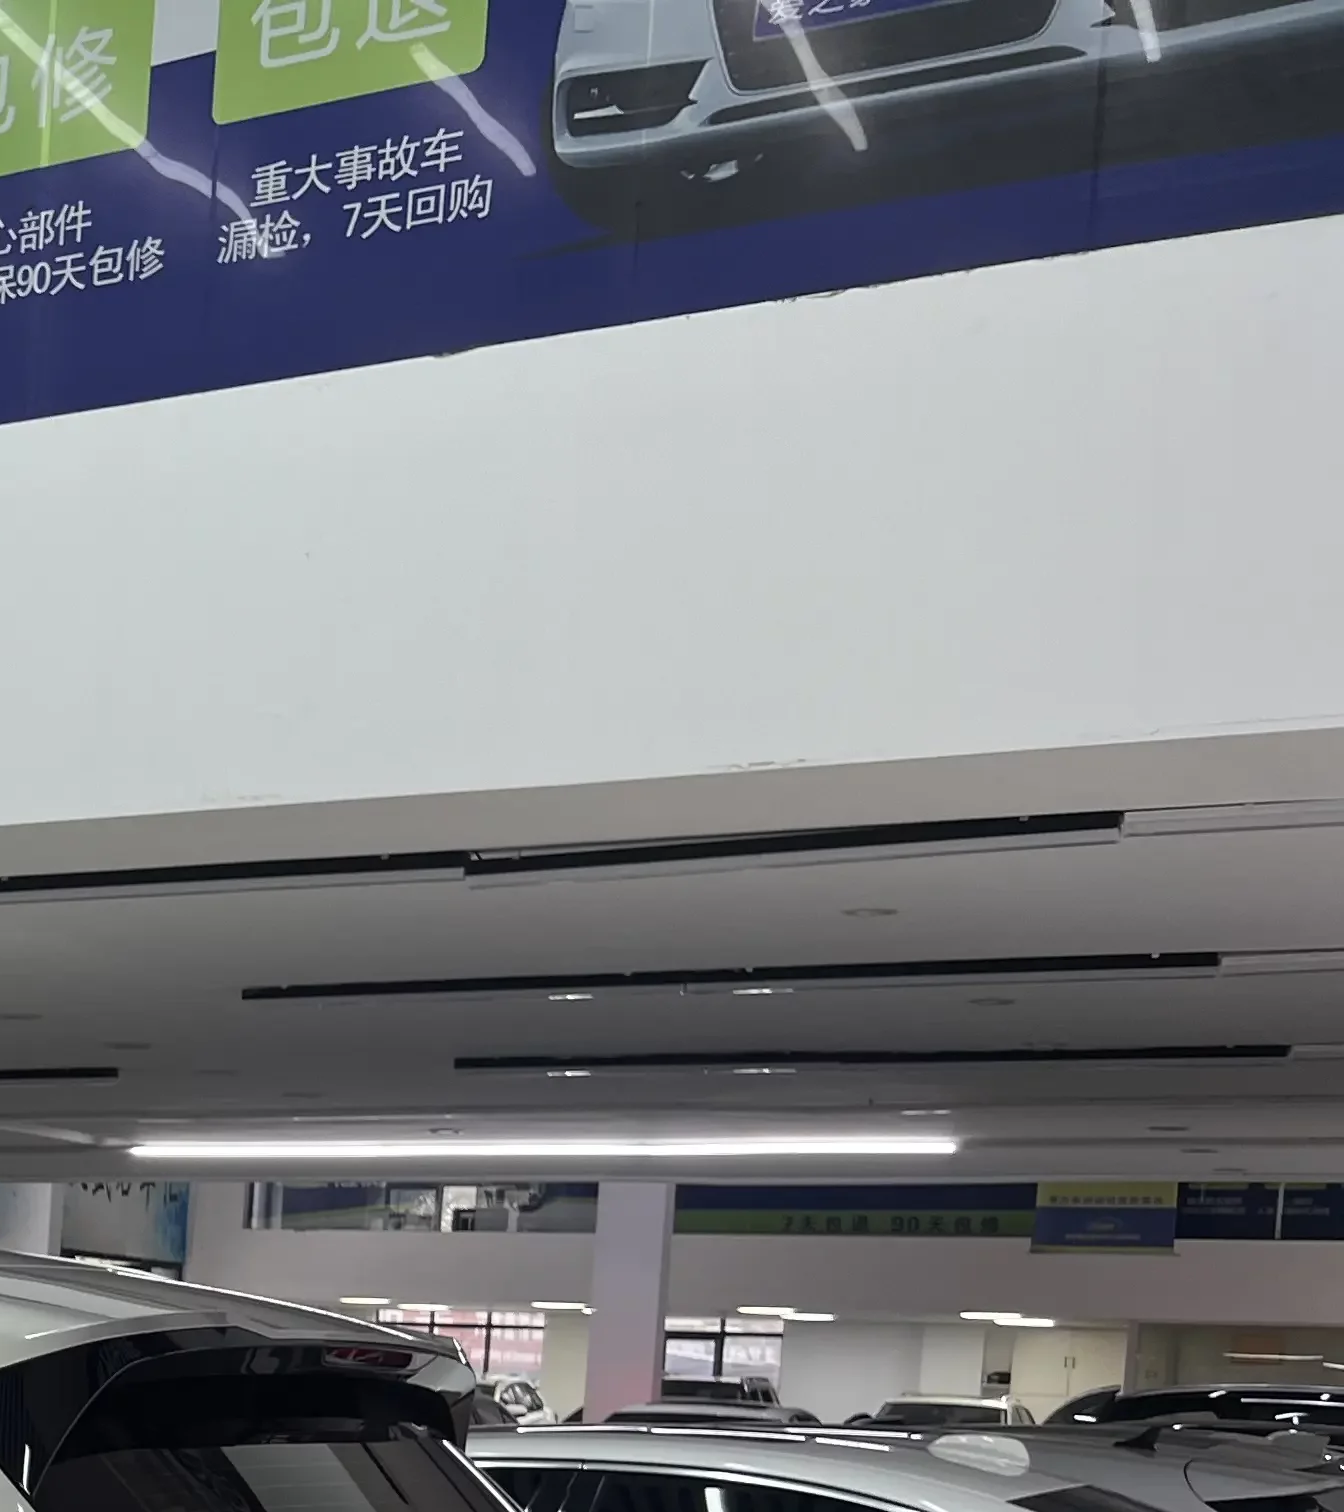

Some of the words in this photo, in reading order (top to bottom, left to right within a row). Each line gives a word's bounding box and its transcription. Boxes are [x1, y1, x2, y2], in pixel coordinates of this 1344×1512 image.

[769, 0, 871, 24] 爱之
[251, 129, 464, 205] 重大事故车
